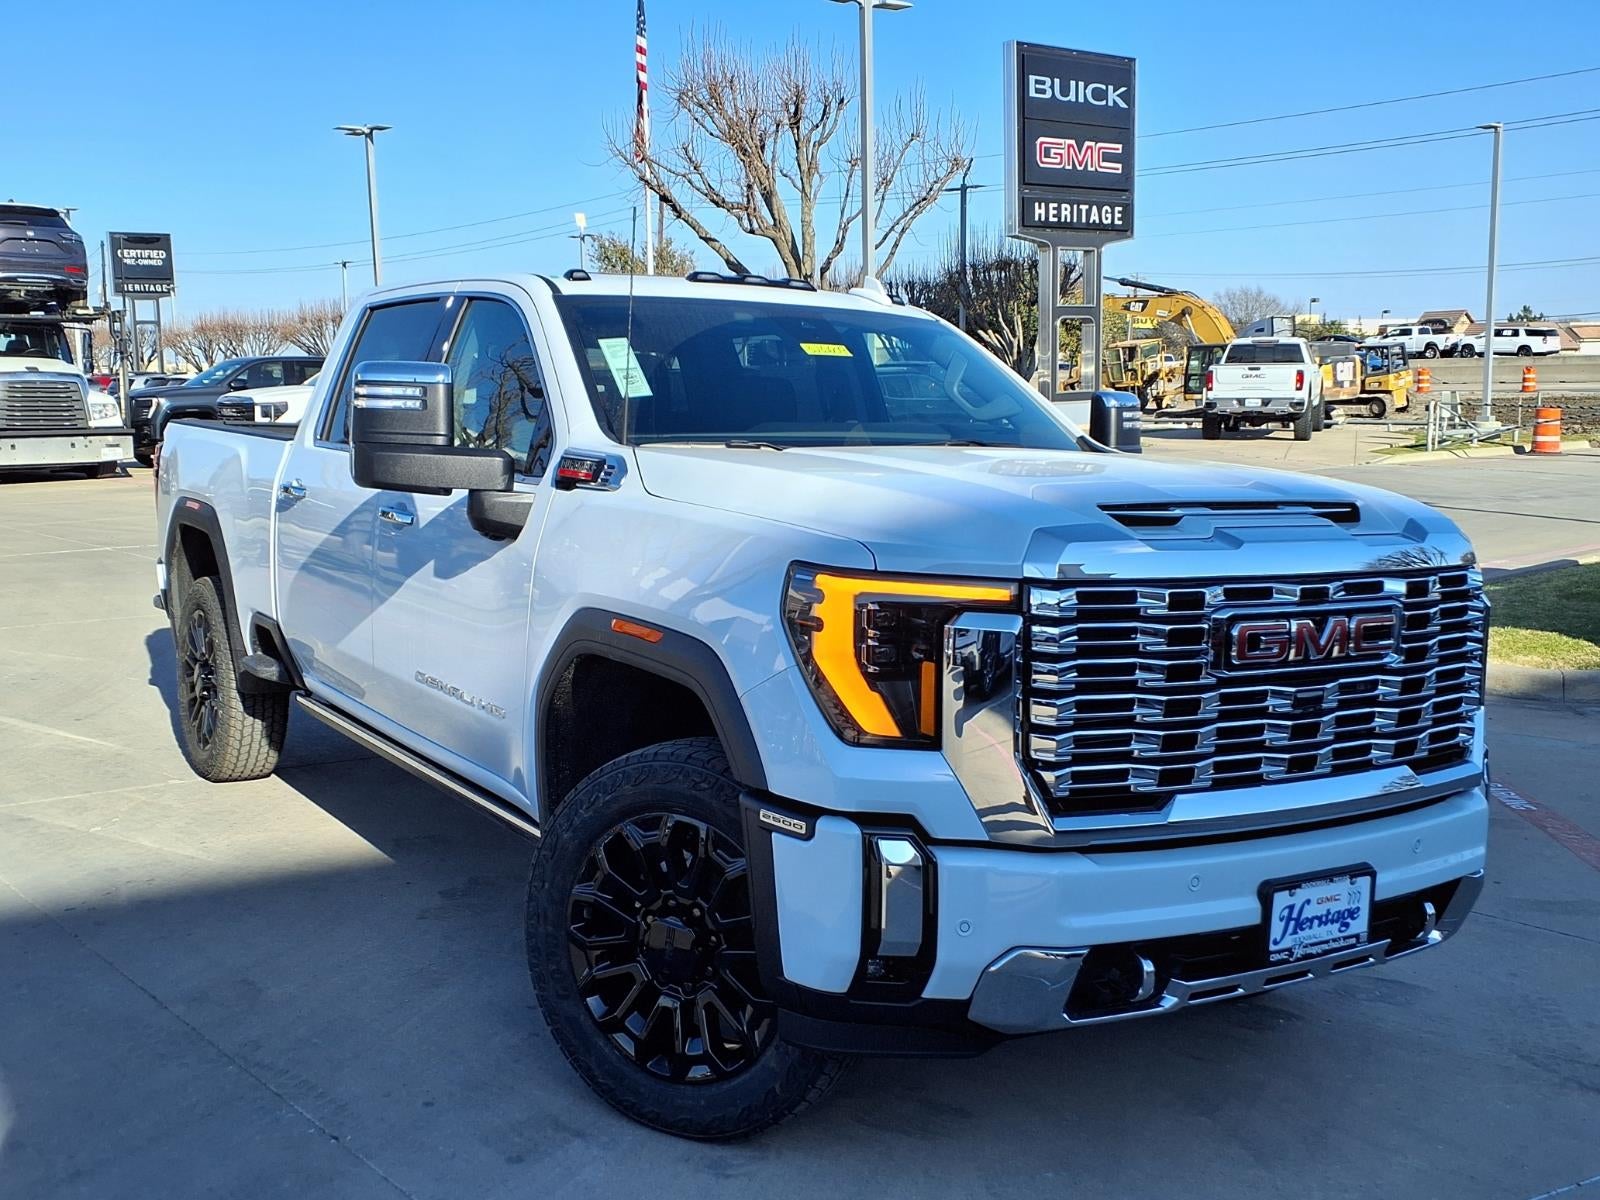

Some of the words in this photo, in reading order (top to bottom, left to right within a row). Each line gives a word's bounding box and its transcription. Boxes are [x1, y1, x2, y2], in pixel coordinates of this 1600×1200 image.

[1028, 75, 1129, 109] BUICK
[1036, 136, 1123, 174] GMC
[1034, 202, 1124, 225] HERITAGE
[117, 249, 166, 258] CERTIFIED
[1129, 301, 1144, 312] CAT
[1231, 615, 1396, 664] GMC
[761, 812, 803, 830] 2500
[1316, 894, 1342, 905] GMC
[1271, 898, 1361, 946] Heritage
